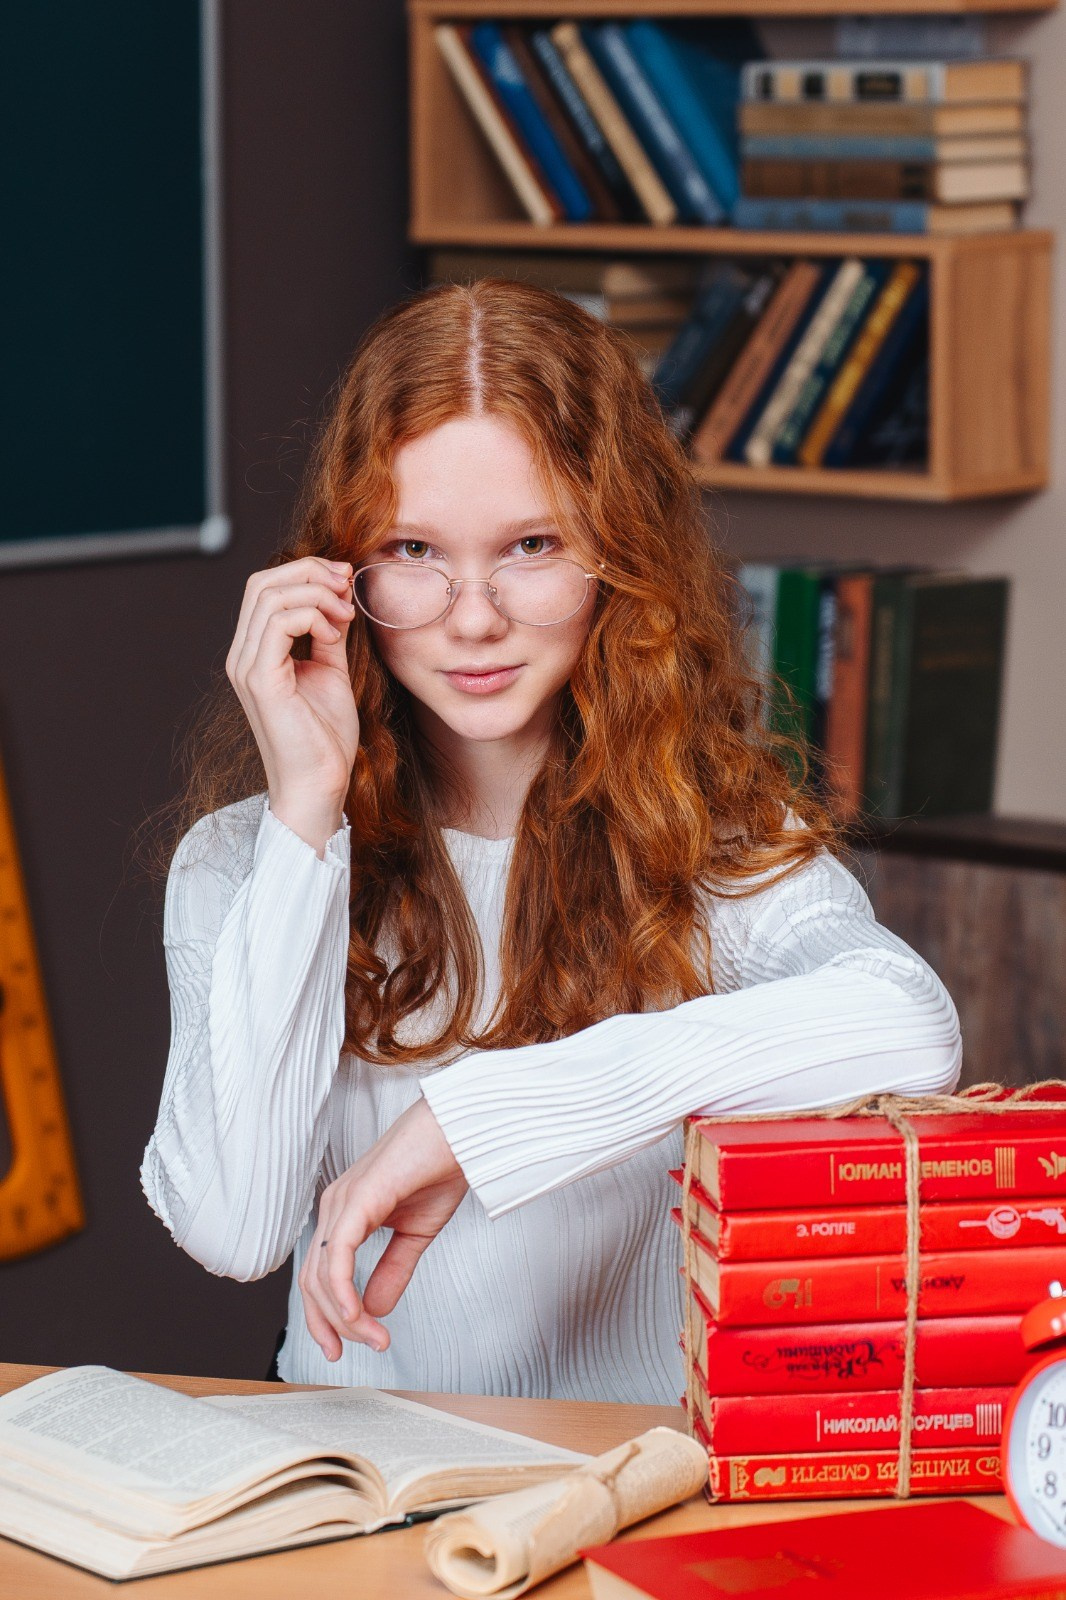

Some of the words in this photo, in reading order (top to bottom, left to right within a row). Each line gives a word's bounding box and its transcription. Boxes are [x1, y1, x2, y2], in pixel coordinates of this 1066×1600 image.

[838, 1162, 902, 1181] ЮЛИАН
[910, 1159, 993, 1179] ЕМЕНОВ
[823, 1414, 899, 1434] НИКОЛАЙ
[1048, 1402, 1066, 1429] 10
[1038, 1433, 1051, 1460] 9
[791, 1463, 870, 1483] СМЕРТИ
[877, 1459, 971, 1480] ИМПЕИЯ
[1044, 1471, 1057, 1498] 8
